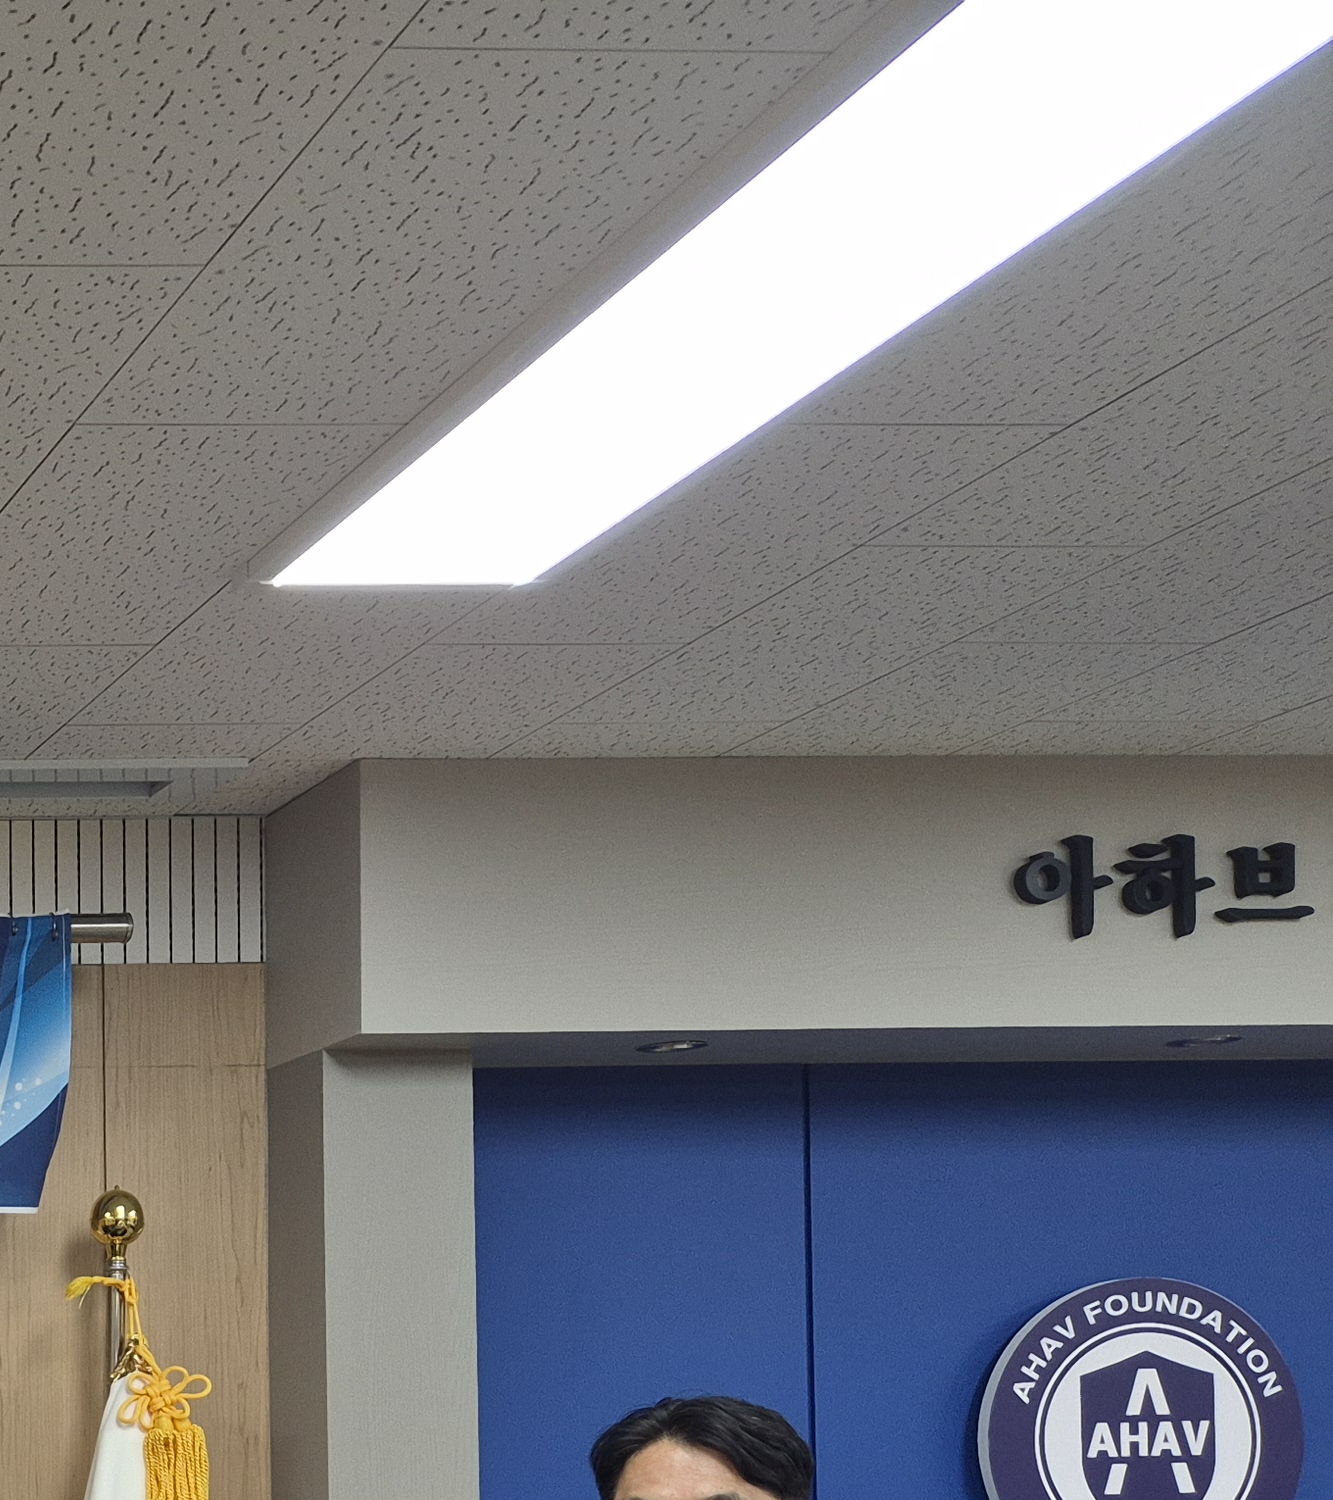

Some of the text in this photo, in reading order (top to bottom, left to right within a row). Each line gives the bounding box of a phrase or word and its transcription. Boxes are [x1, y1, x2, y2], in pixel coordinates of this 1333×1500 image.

[1013, 833, 1316, 940] 아하브
[1011, 1290, 1283, 1405] AHAV FOUNDATION
[1086, 1419, 1211, 1459] AHAV
